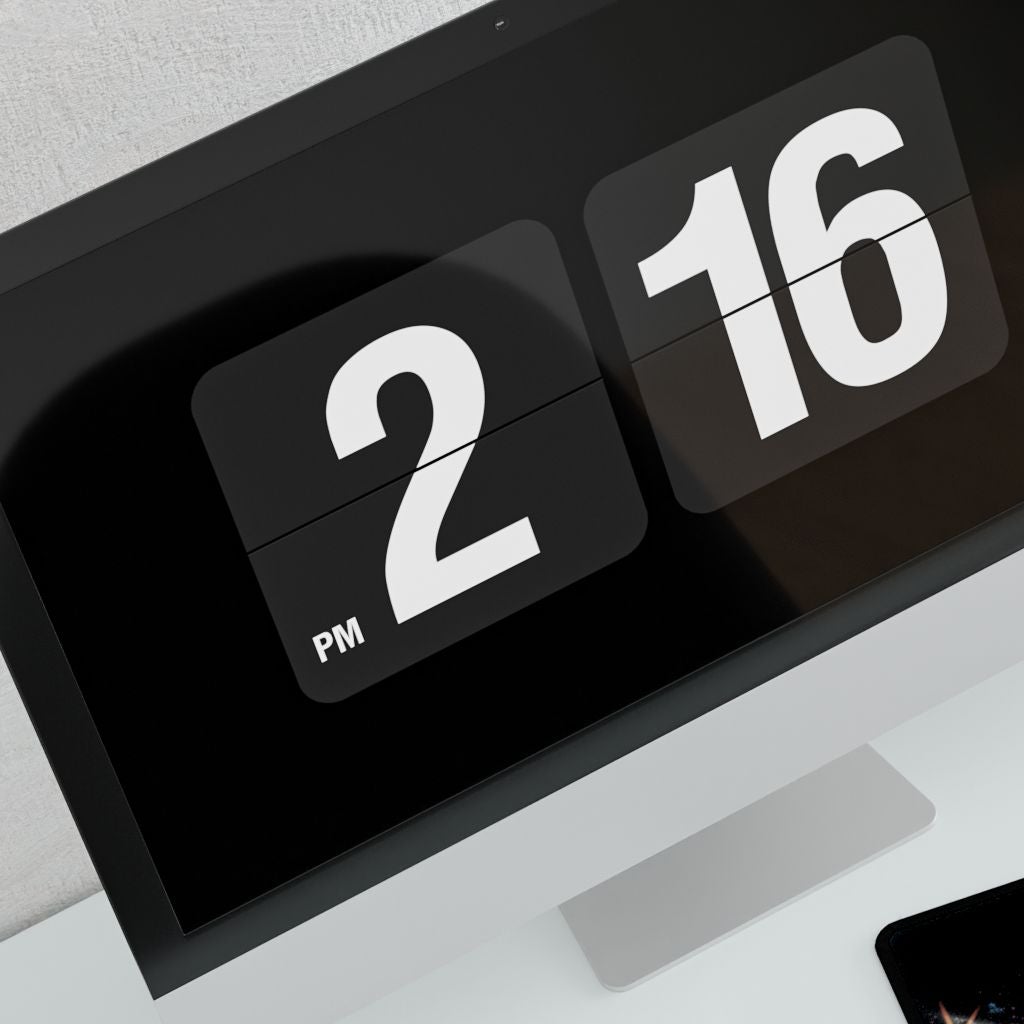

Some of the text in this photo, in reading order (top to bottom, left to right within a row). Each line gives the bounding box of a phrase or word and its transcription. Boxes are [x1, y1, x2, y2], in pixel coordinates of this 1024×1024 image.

[325, 107, 948, 625] 2 16
[312, 616, 365, 664] PM
